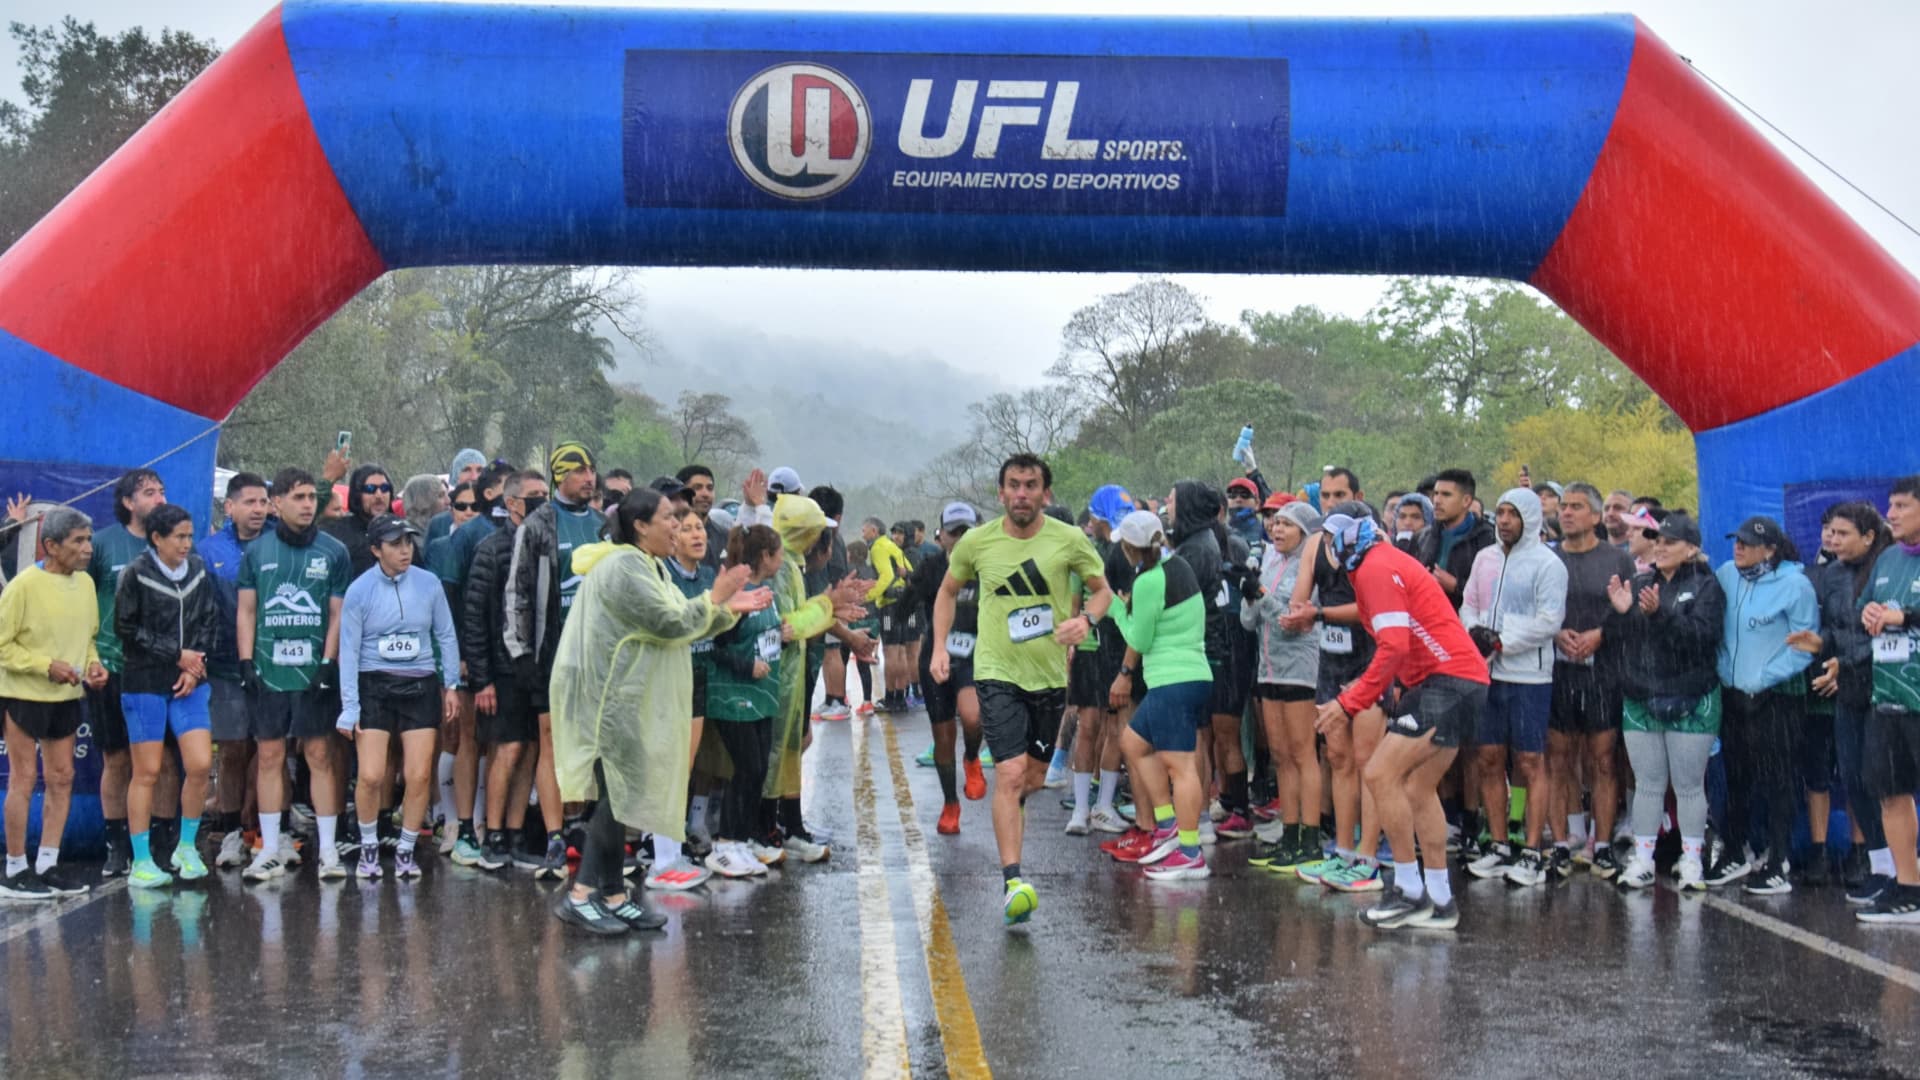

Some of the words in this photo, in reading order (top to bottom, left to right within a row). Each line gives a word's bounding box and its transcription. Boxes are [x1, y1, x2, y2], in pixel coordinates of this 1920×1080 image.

[898, 79, 1099, 160] UFL
[1102, 140, 1187, 161] SPORTS.
[892, 171, 1049, 189] EQUIPAMENTOS
[1052, 173, 1181, 190] DEPORTIVOS
[265, 615, 321, 627] MONTEROS
[1022, 614, 1040, 628] 60
[281, 646, 303, 657] 443
[387, 641, 412, 651] 496
